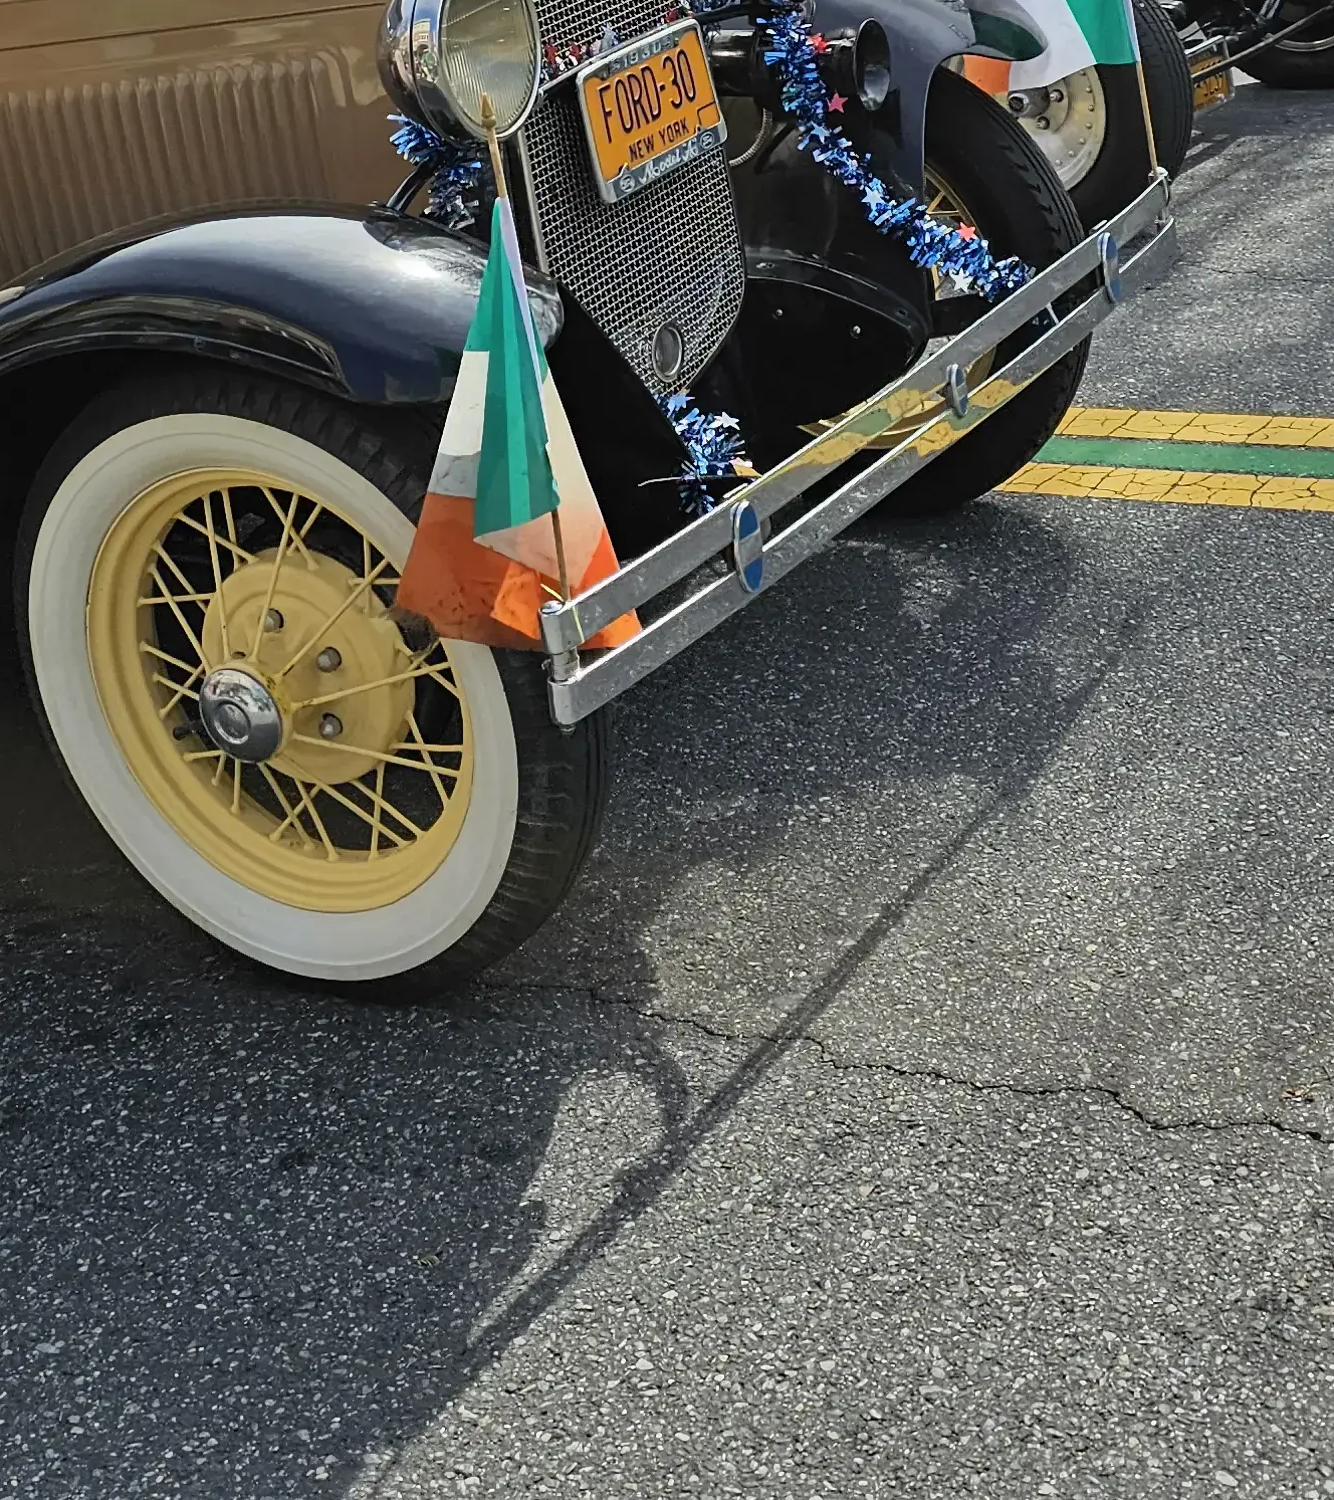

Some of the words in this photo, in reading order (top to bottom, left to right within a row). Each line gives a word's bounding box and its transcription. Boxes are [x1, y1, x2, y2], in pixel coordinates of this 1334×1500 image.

[597, 48, 697, 145] FORD-30
[628, 132, 655, 162] NEW
[659, 116, 690, 145] YORK
[638, 149, 680, 182] Model
